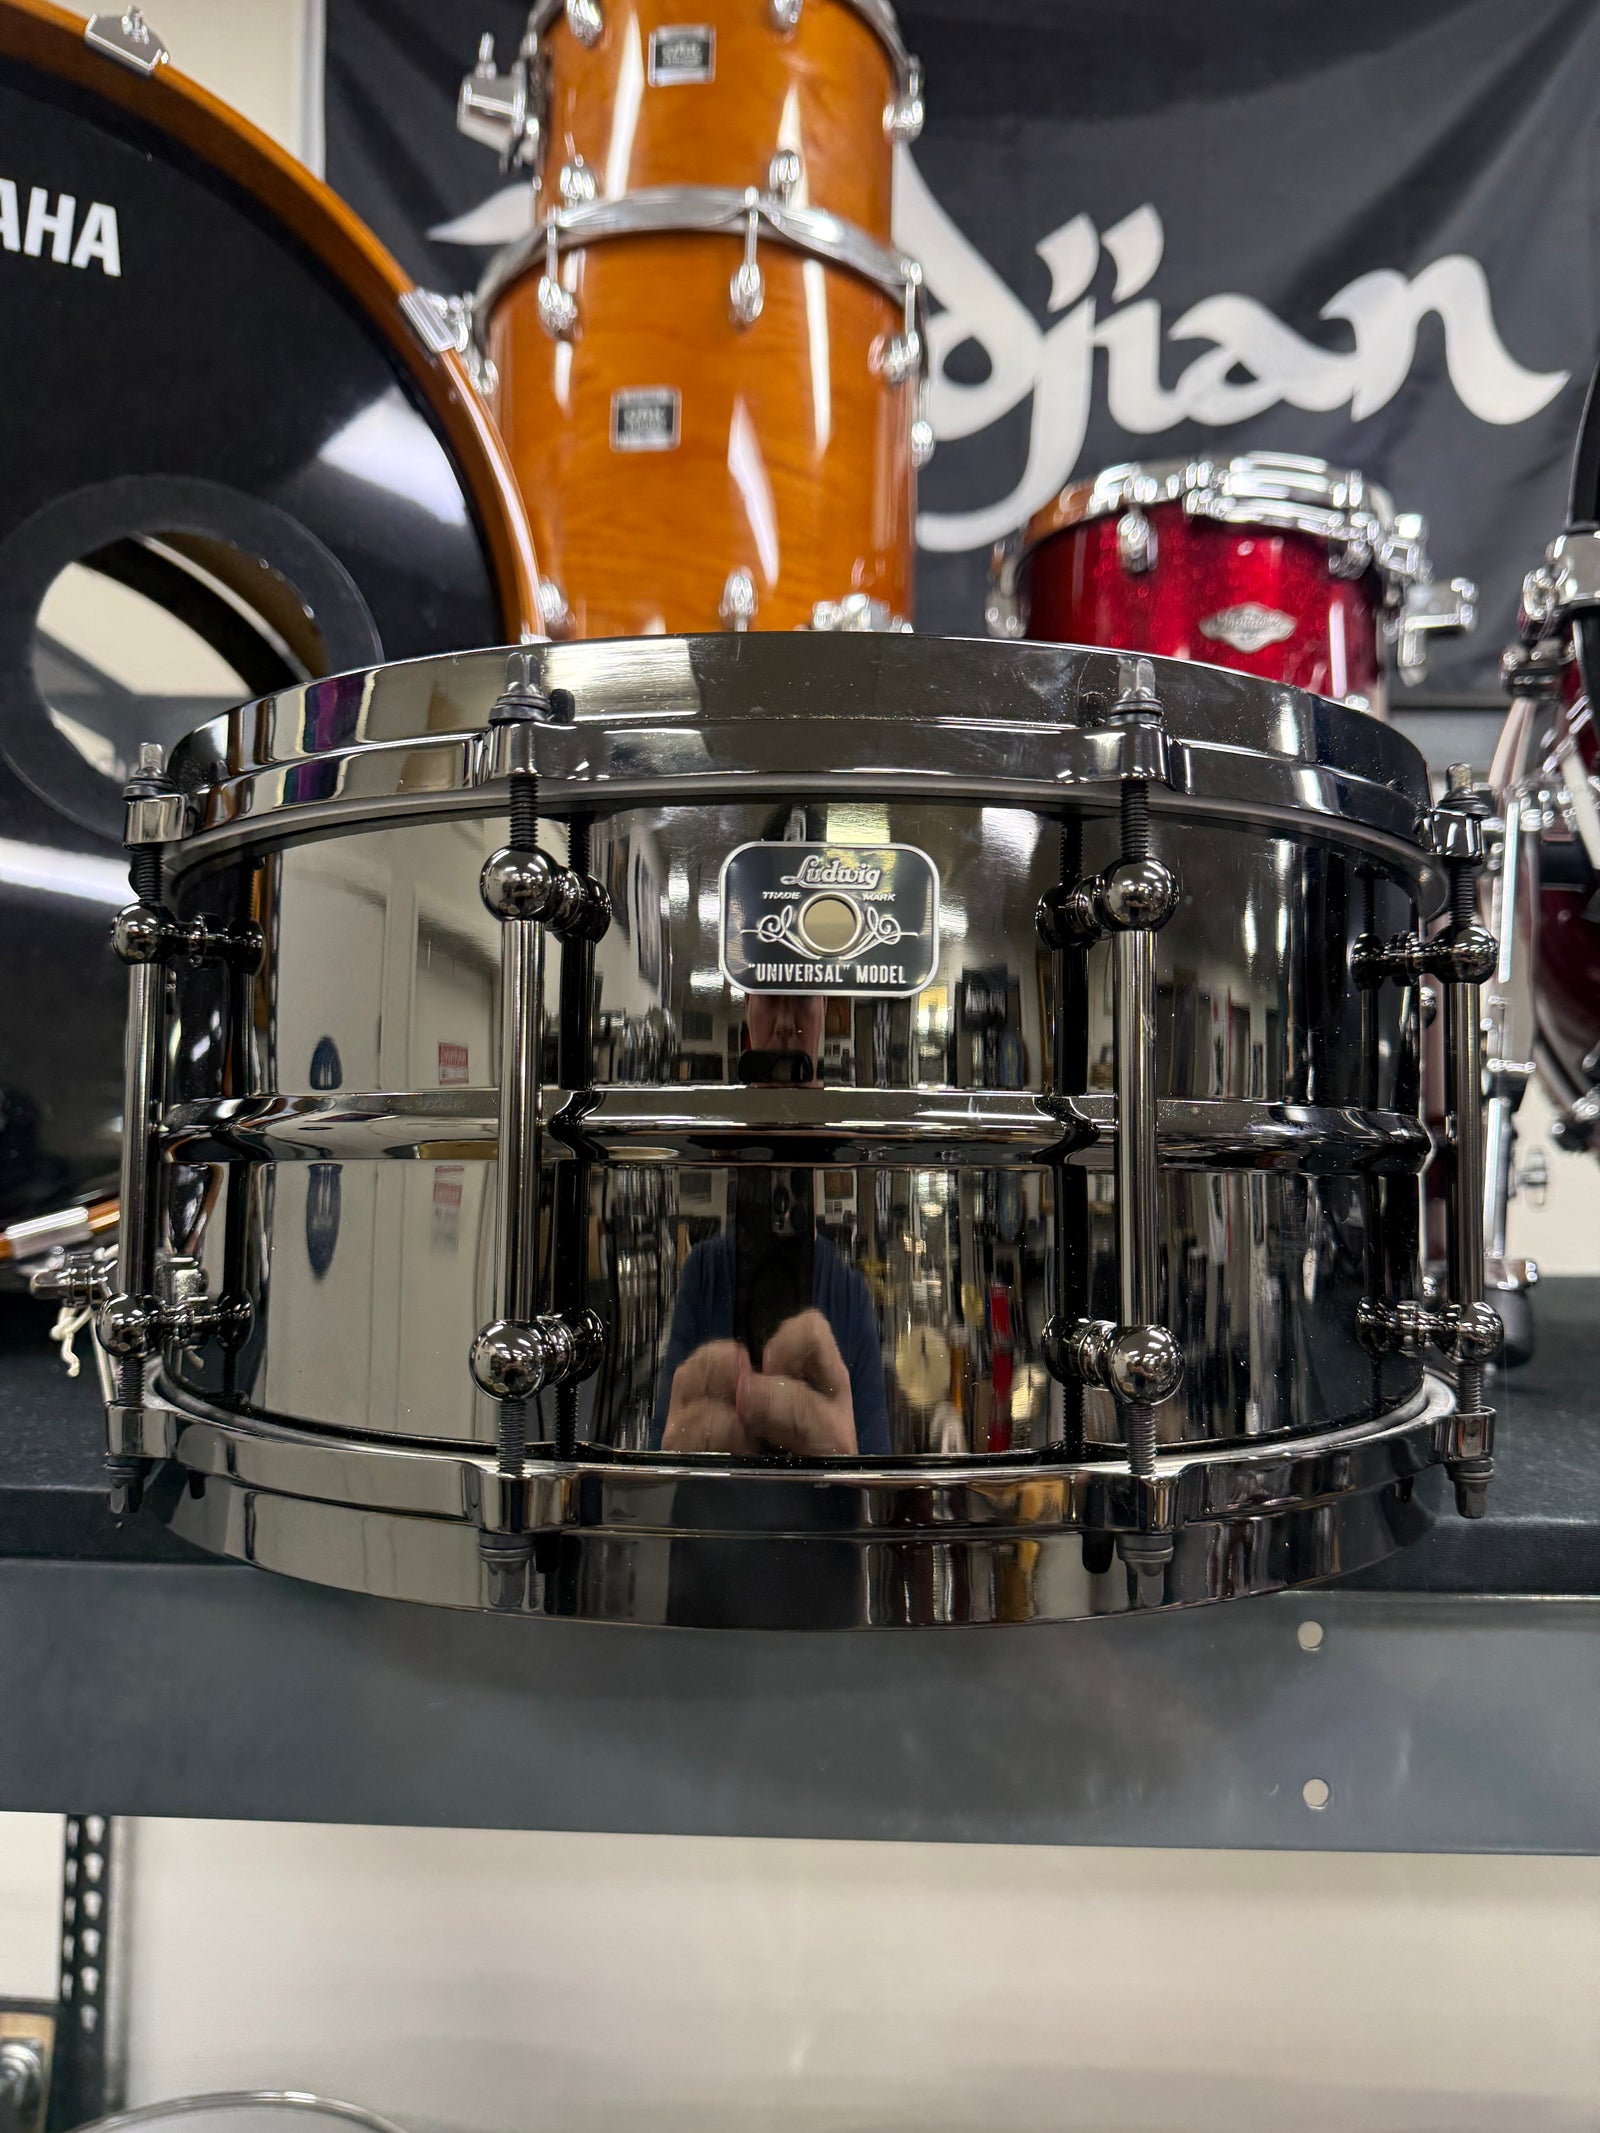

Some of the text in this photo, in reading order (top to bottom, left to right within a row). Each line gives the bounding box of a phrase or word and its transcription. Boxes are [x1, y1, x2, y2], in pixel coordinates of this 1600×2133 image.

[780, 855, 881, 890] Ludwig
[762, 891, 896, 902] TRADE MARK
[855, 964, 907, 984] MODEL
